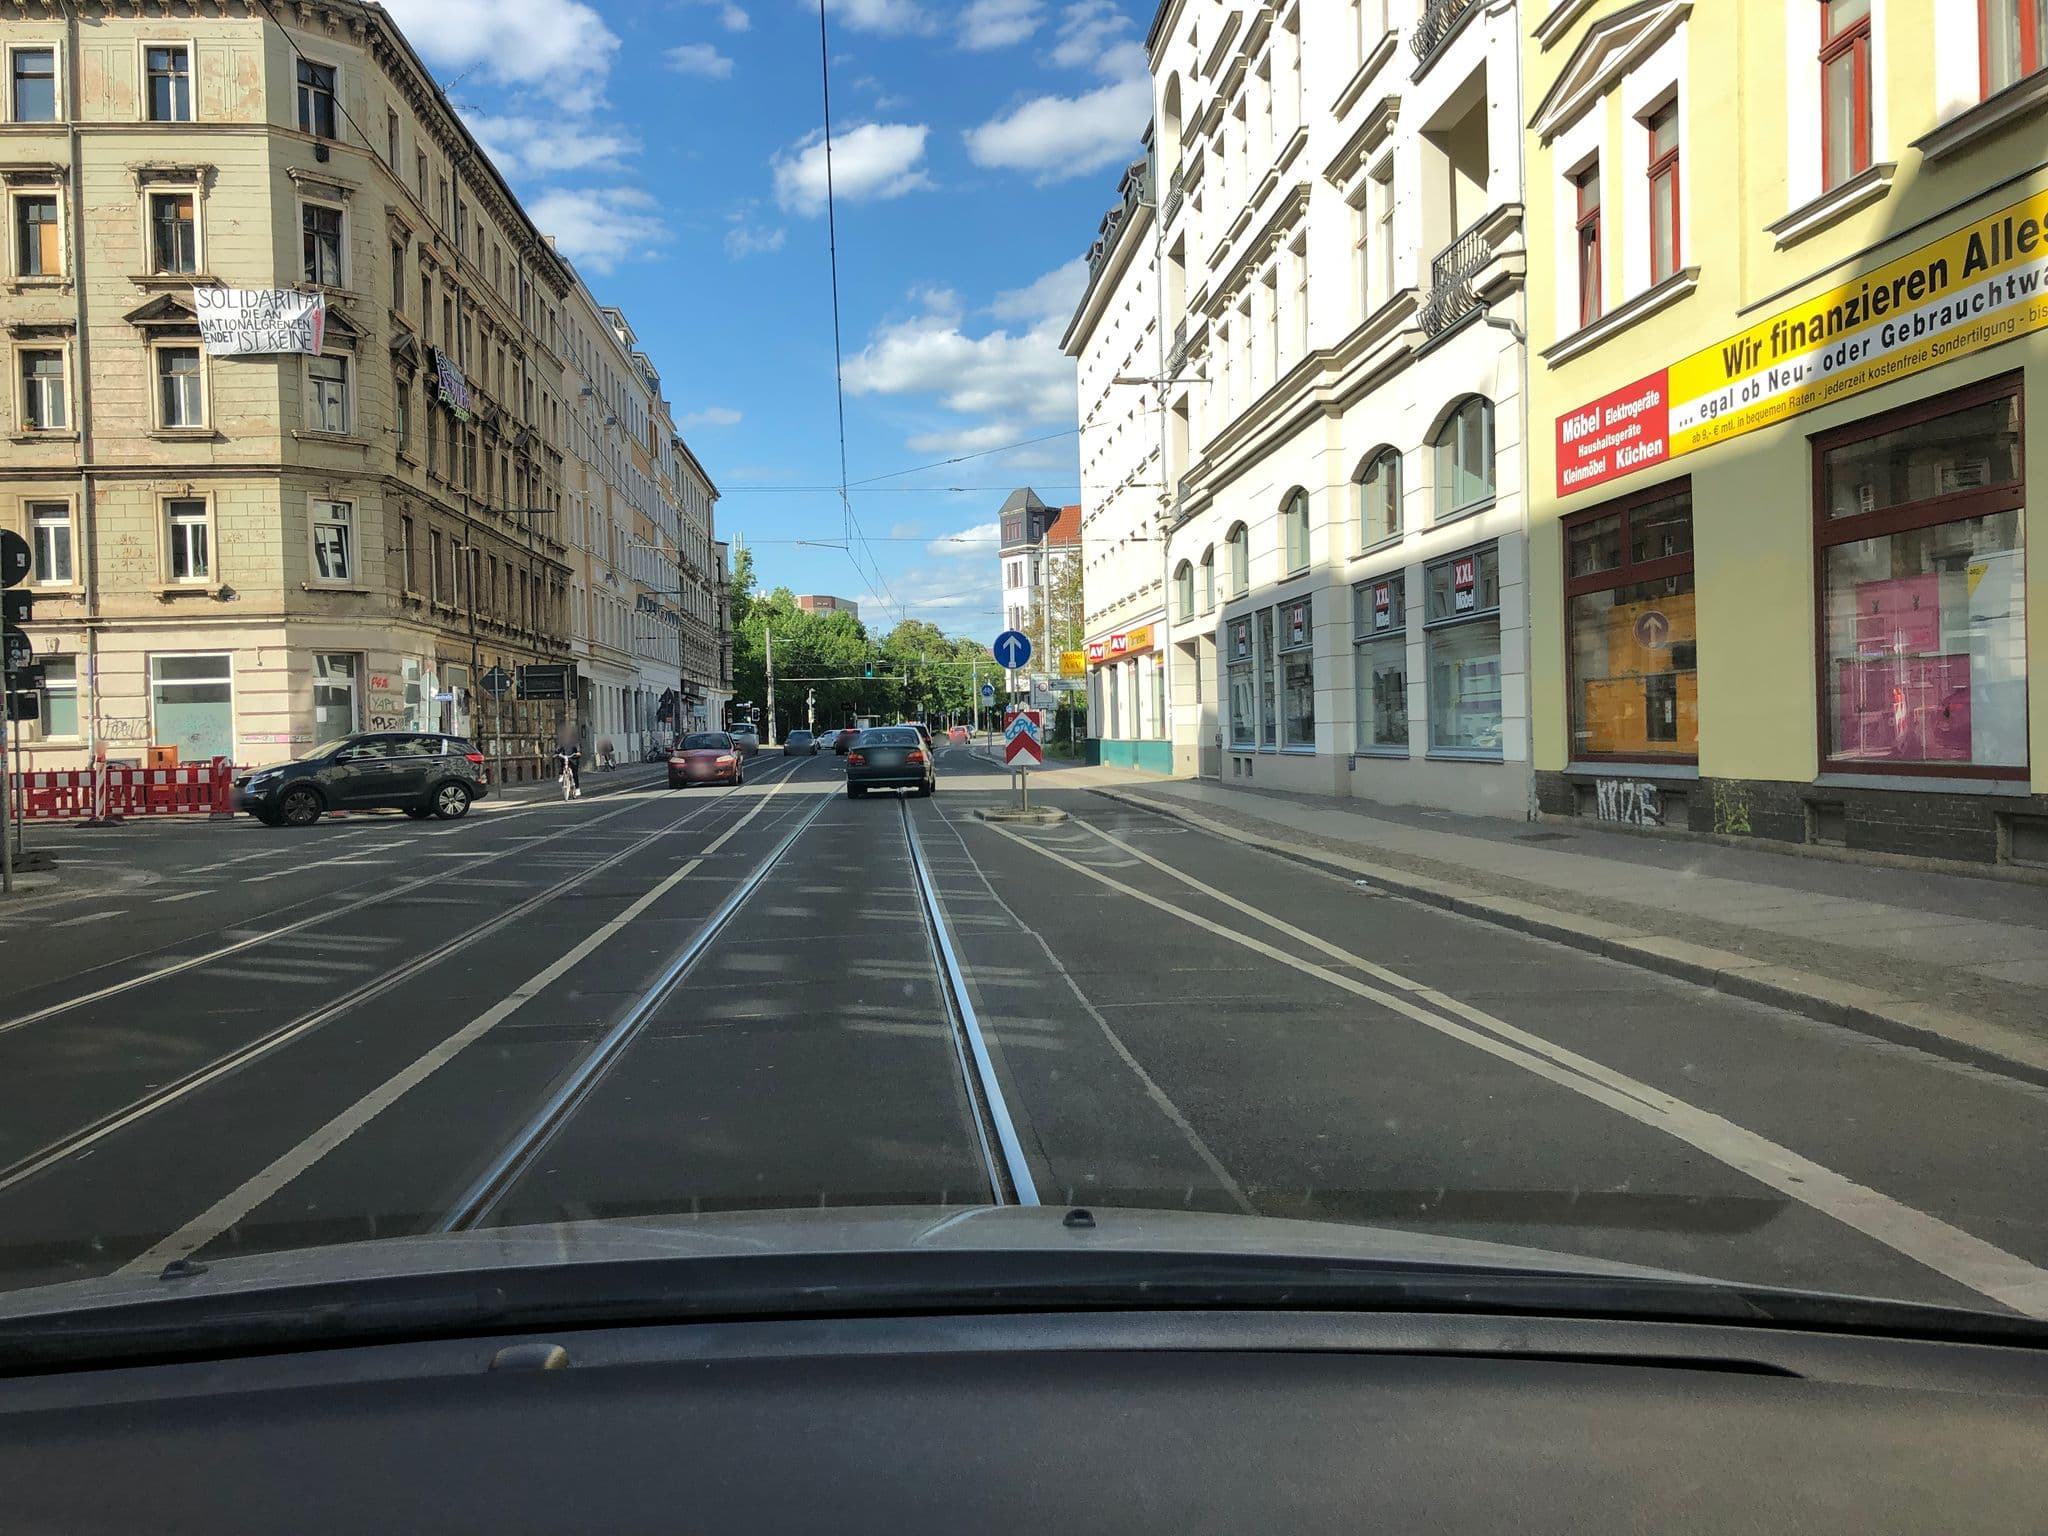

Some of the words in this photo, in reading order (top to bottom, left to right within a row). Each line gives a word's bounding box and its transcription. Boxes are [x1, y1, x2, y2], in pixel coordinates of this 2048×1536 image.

[1722, 336, 1762, 378] Wir
[1770, 257, 1948, 359] finanzieren
[1962, 211, 2048, 279] Alle
[200, 319, 311, 331] NATIONALGRENZEN
[241, 309, 260, 319] DIE
[263, 309, 281, 319] AN
[202, 331, 233, 344] ENDET
[238, 331, 260, 352] IST
[267, 330, 312, 351] KEINE
[1692, 432, 1701, 444] ab
[1713, 424, 1719, 436] €
[1737, 416, 1744, 428] in
[1746, 401, 1786, 425] bequemen
[1789, 390, 1815, 409] Raten
[1824, 369, 1866, 400] jederzeit
[1868, 349, 1928, 381] kostenfreie
[1931, 316, 2015, 358] Sondertilgung
[1700, 388, 1733, 419] egal
[1741, 379, 1760, 402] ob
[1768, 365, 1812, 392] Neu-
[1823, 337, 1870, 371] oder
[1562, 407, 1600, 444] Möbel
[1605, 390, 1660, 426] Elektrogeräte
[1578, 424, 1641, 457] Haushaltsgeräte
[1563, 456, 1606, 486] Kleinmöbel
[1616, 438, 1663, 469] Küchen
[1456, 563, 1473, 584] XXL
[1376, 588, 1389, 605] XXL
[1456, 589, 1473, 610] Möbel
